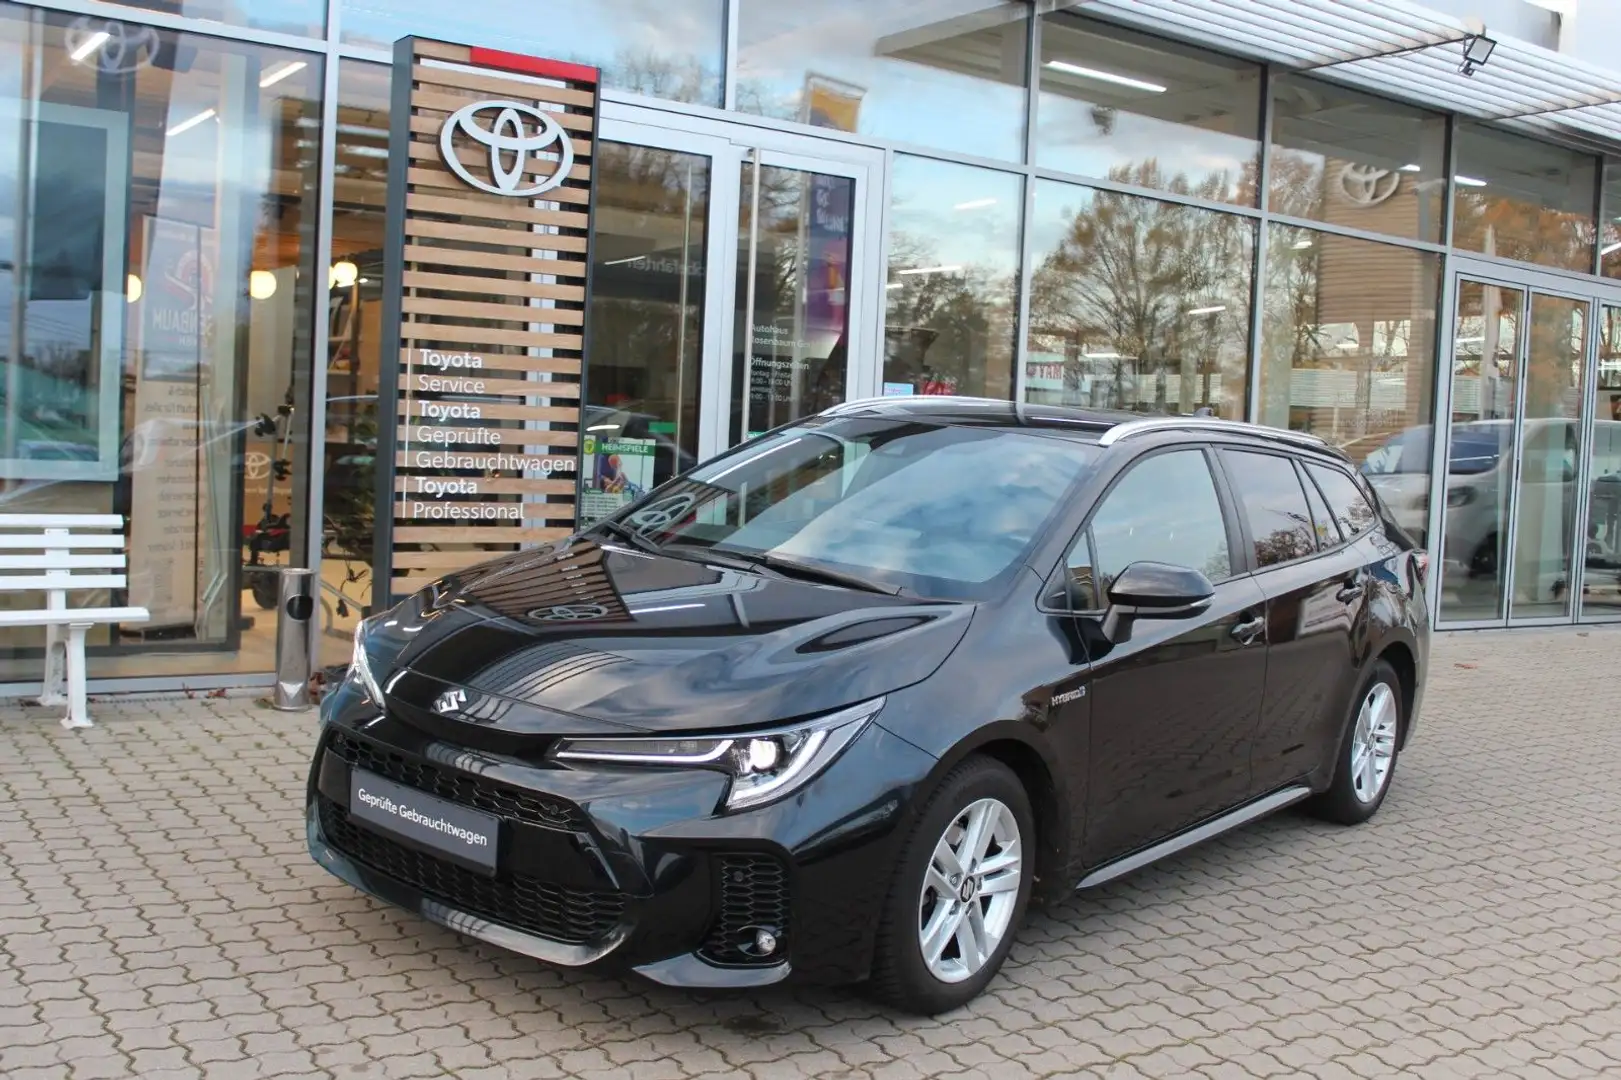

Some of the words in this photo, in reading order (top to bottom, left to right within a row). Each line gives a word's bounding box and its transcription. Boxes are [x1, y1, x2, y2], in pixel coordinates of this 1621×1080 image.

[419, 348, 483, 370] Toyota
[417, 374, 485, 394] Service
[417, 400, 482, 422] Toyota
[416, 425, 501, 447] Geprüfte
[601, 442, 649, 454] HEIMSPIELE
[415, 450, 576, 475] Gebrauchtwagen
[414, 476, 478, 499] Toyota
[413, 502, 525, 520] Professional
[358, 787, 398, 815] Geprüfte
[399, 804, 488, 847] Gebrauchtwagen
